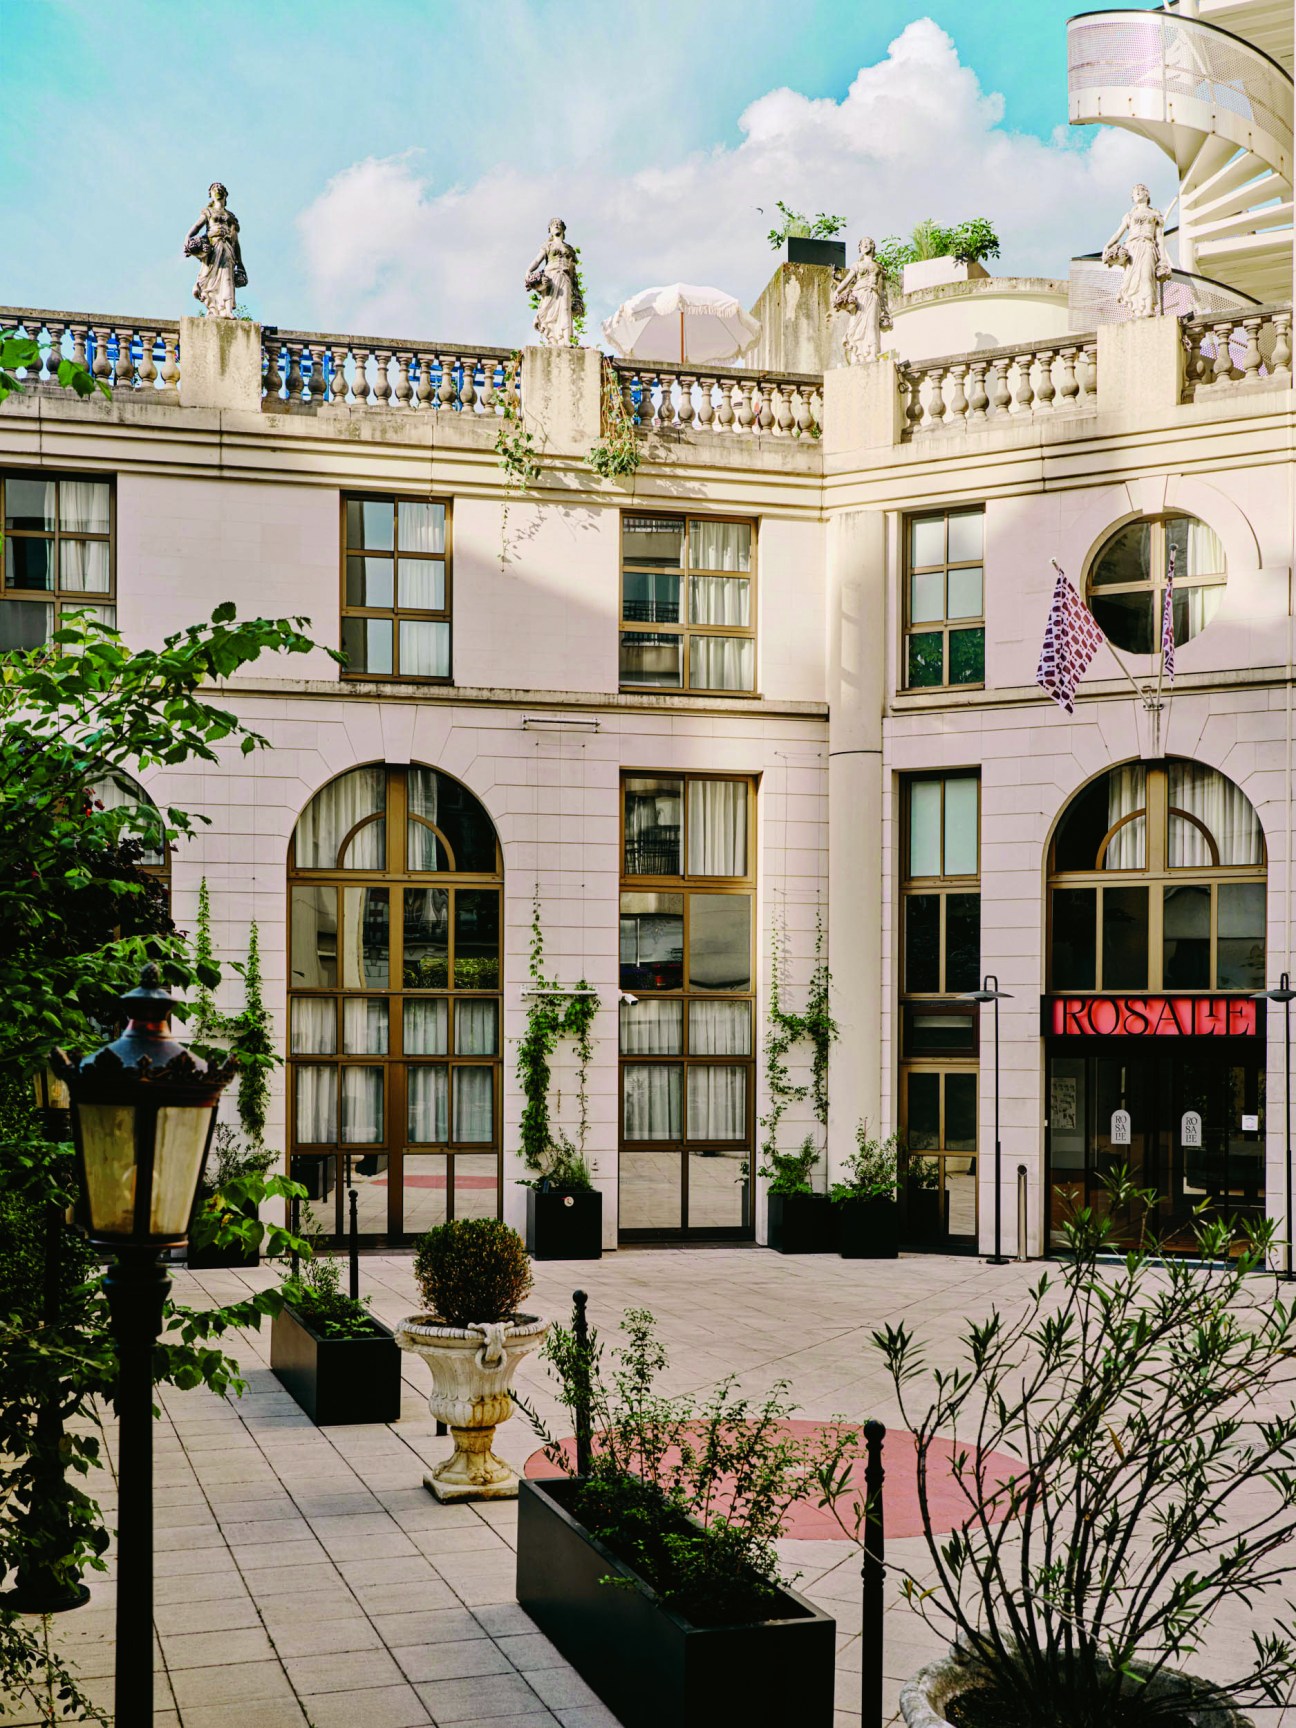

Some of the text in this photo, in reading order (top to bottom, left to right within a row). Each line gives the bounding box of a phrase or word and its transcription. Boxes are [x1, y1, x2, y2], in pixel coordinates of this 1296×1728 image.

[1115, 1115, 1127, 1123] RO
[1186, 1117, 1198, 1125] RO
[1115, 1124, 1127, 1132] SA
[1185, 1126, 1197, 1134] SA
